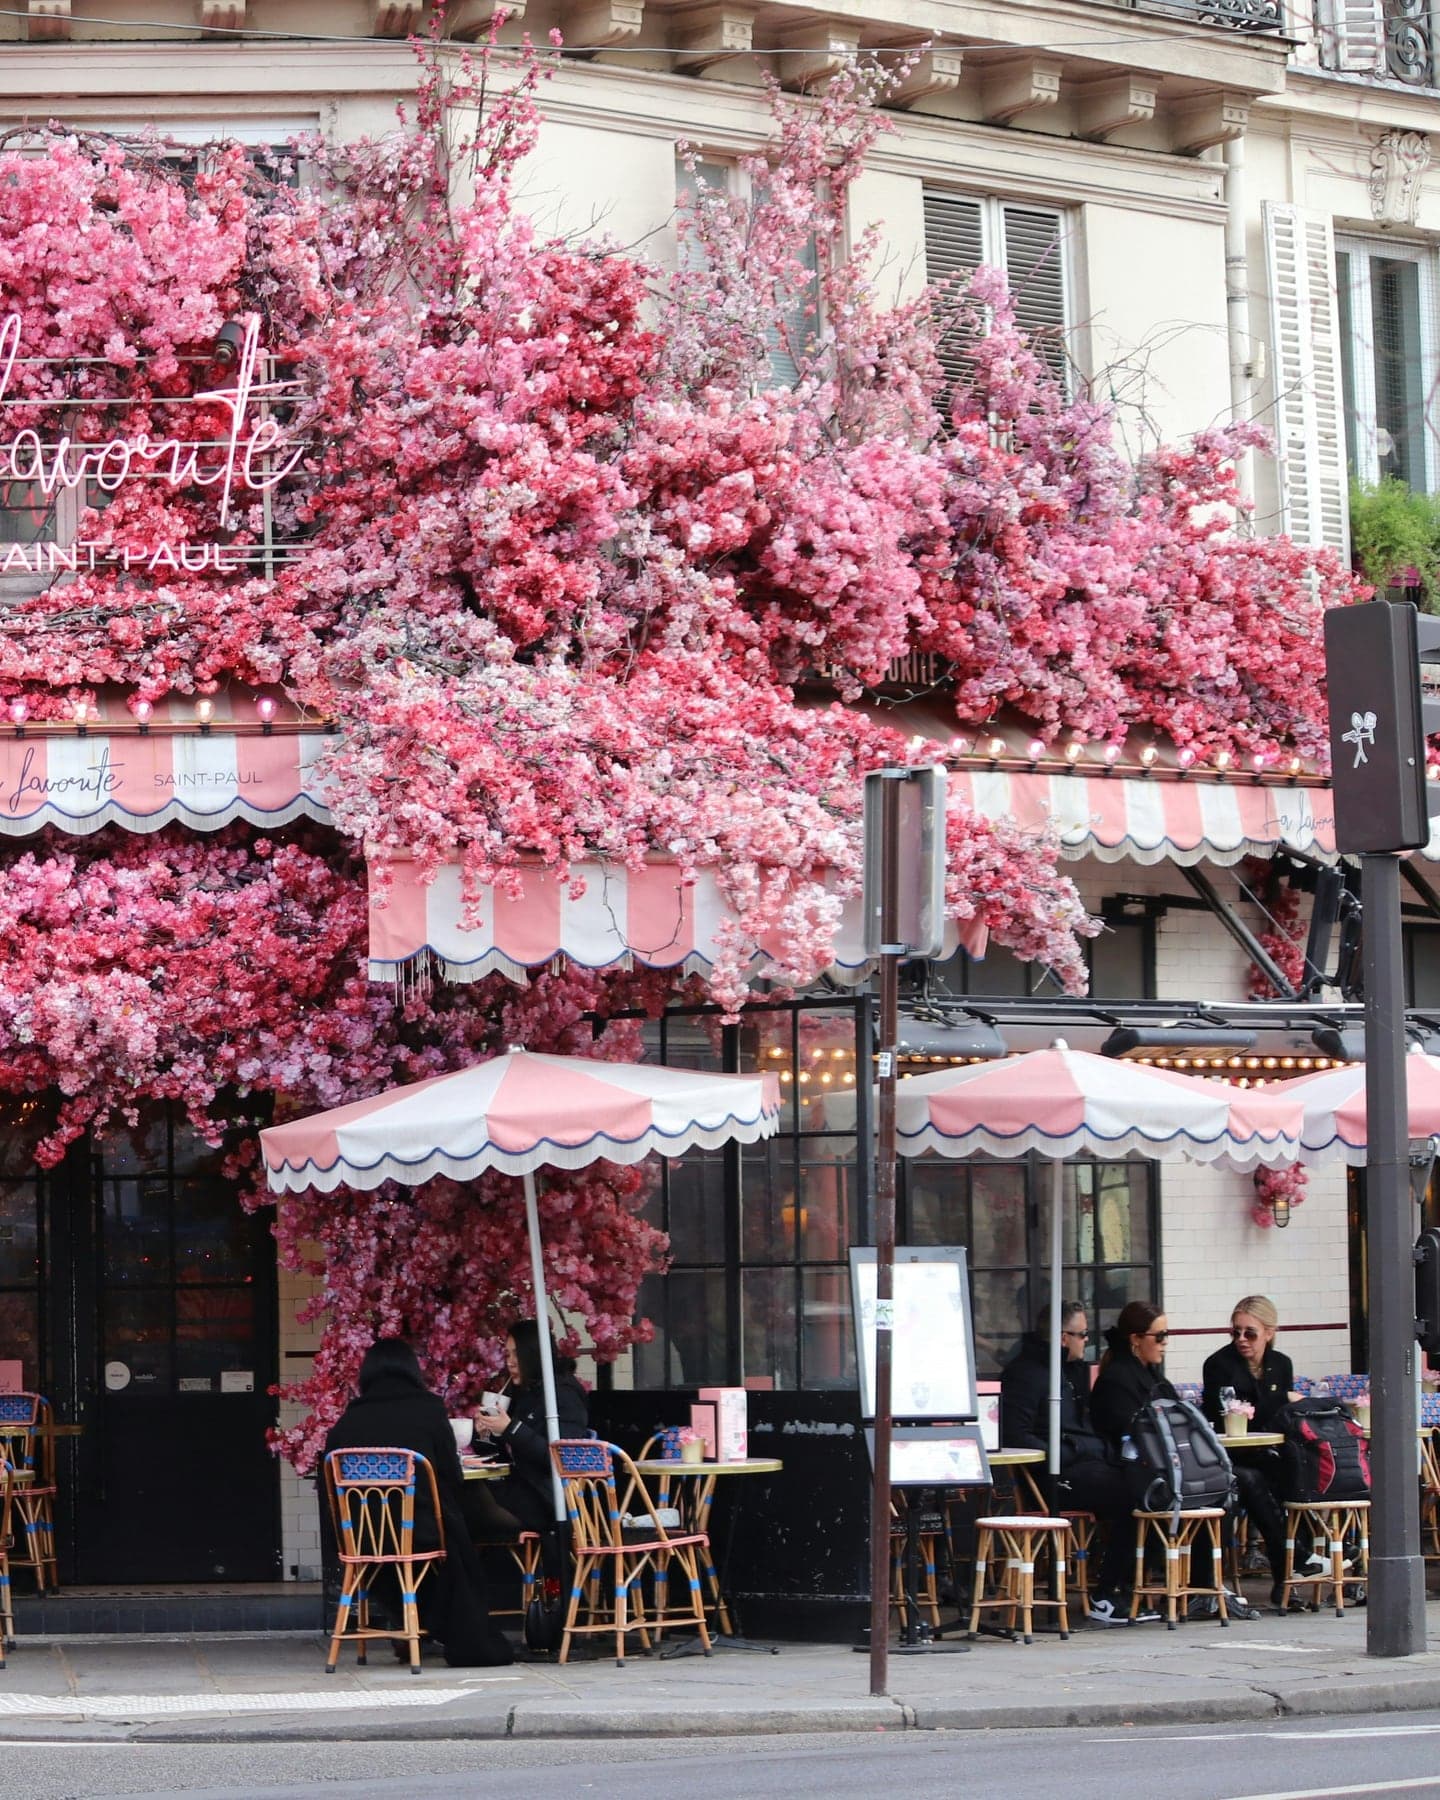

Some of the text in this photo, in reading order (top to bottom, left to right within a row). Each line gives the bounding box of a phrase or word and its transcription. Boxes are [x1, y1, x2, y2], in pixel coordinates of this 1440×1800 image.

[2, 542, 237, 571] AINT-PAUL
[9, 747, 125, 812] favorite
[154, 771, 263, 787] SAINT-PAUL
